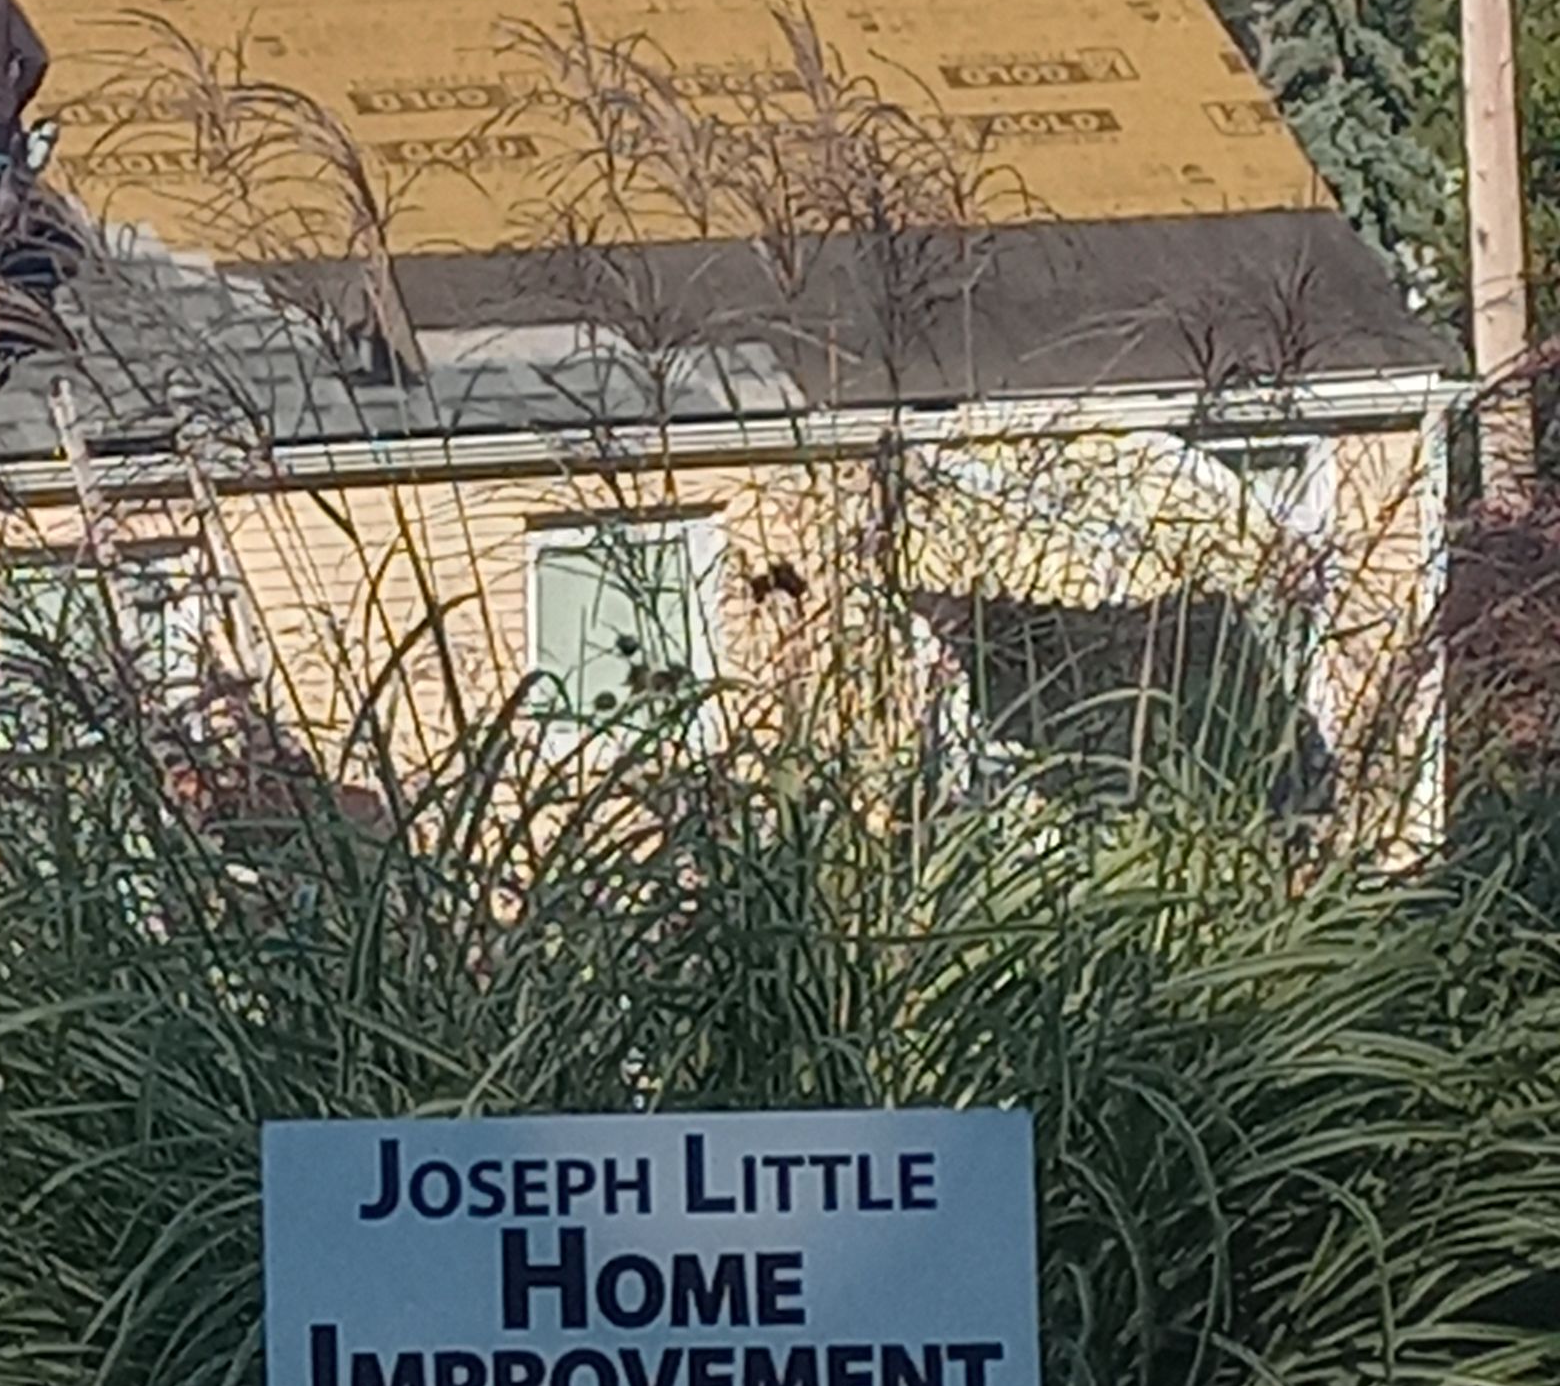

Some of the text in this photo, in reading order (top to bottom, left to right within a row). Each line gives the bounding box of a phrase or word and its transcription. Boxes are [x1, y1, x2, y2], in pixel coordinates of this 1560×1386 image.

[958, 63, 1070, 86] GOLD
[990, 112, 1101, 133] GOLD
[358, 1133, 937, 1220] JOSEPH LITTLE
[500, 1226, 806, 1330] HOME
